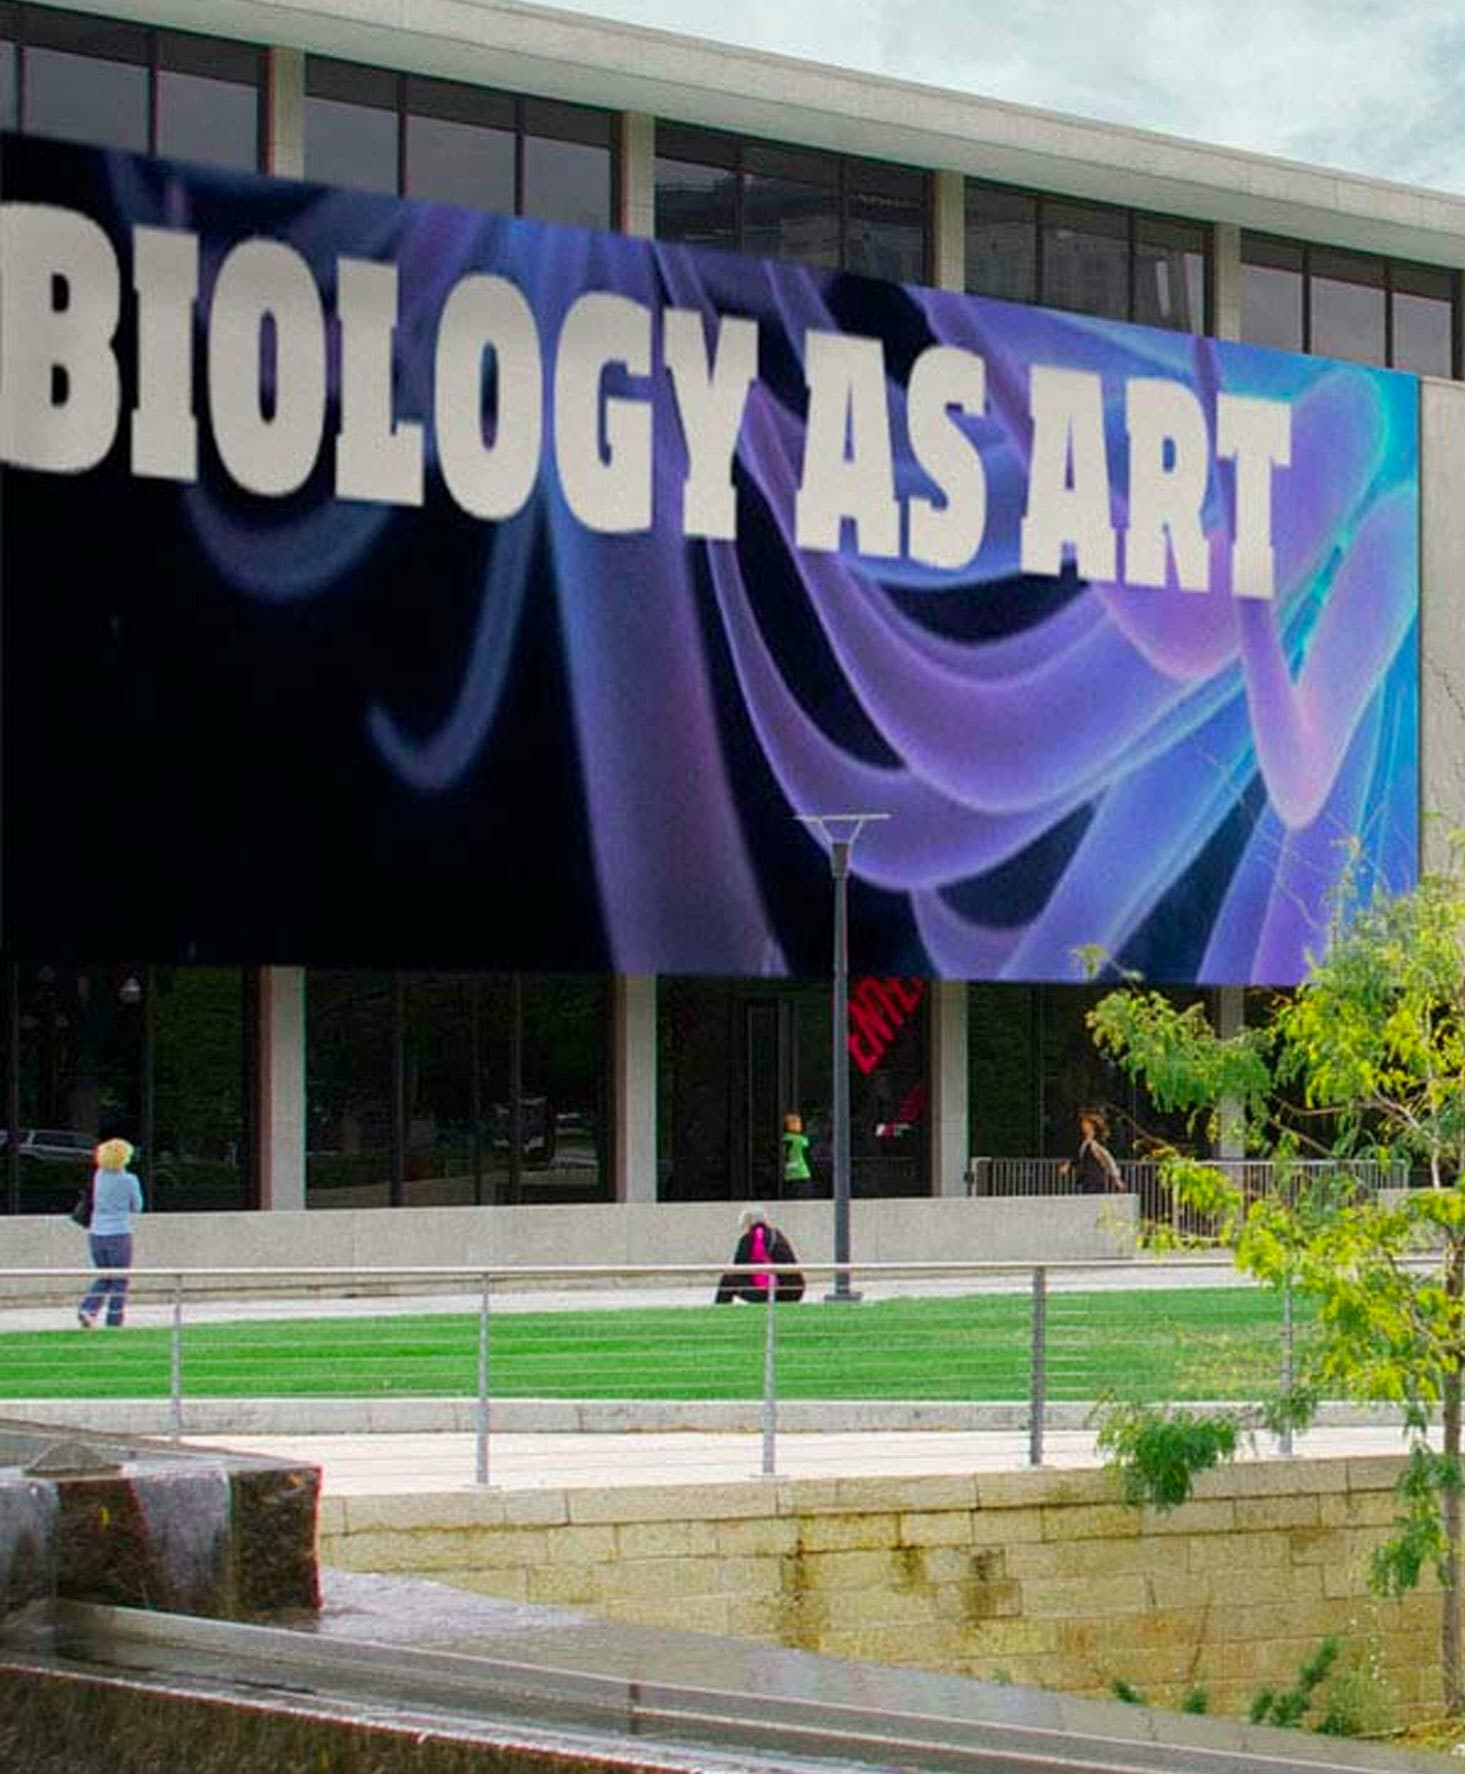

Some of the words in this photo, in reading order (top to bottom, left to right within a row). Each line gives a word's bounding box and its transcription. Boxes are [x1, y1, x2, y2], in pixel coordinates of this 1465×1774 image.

[0, 202, 759, 542] BIOLOGY
[795, 331, 988, 570] AS
[1019, 363, 1294, 605] ART
